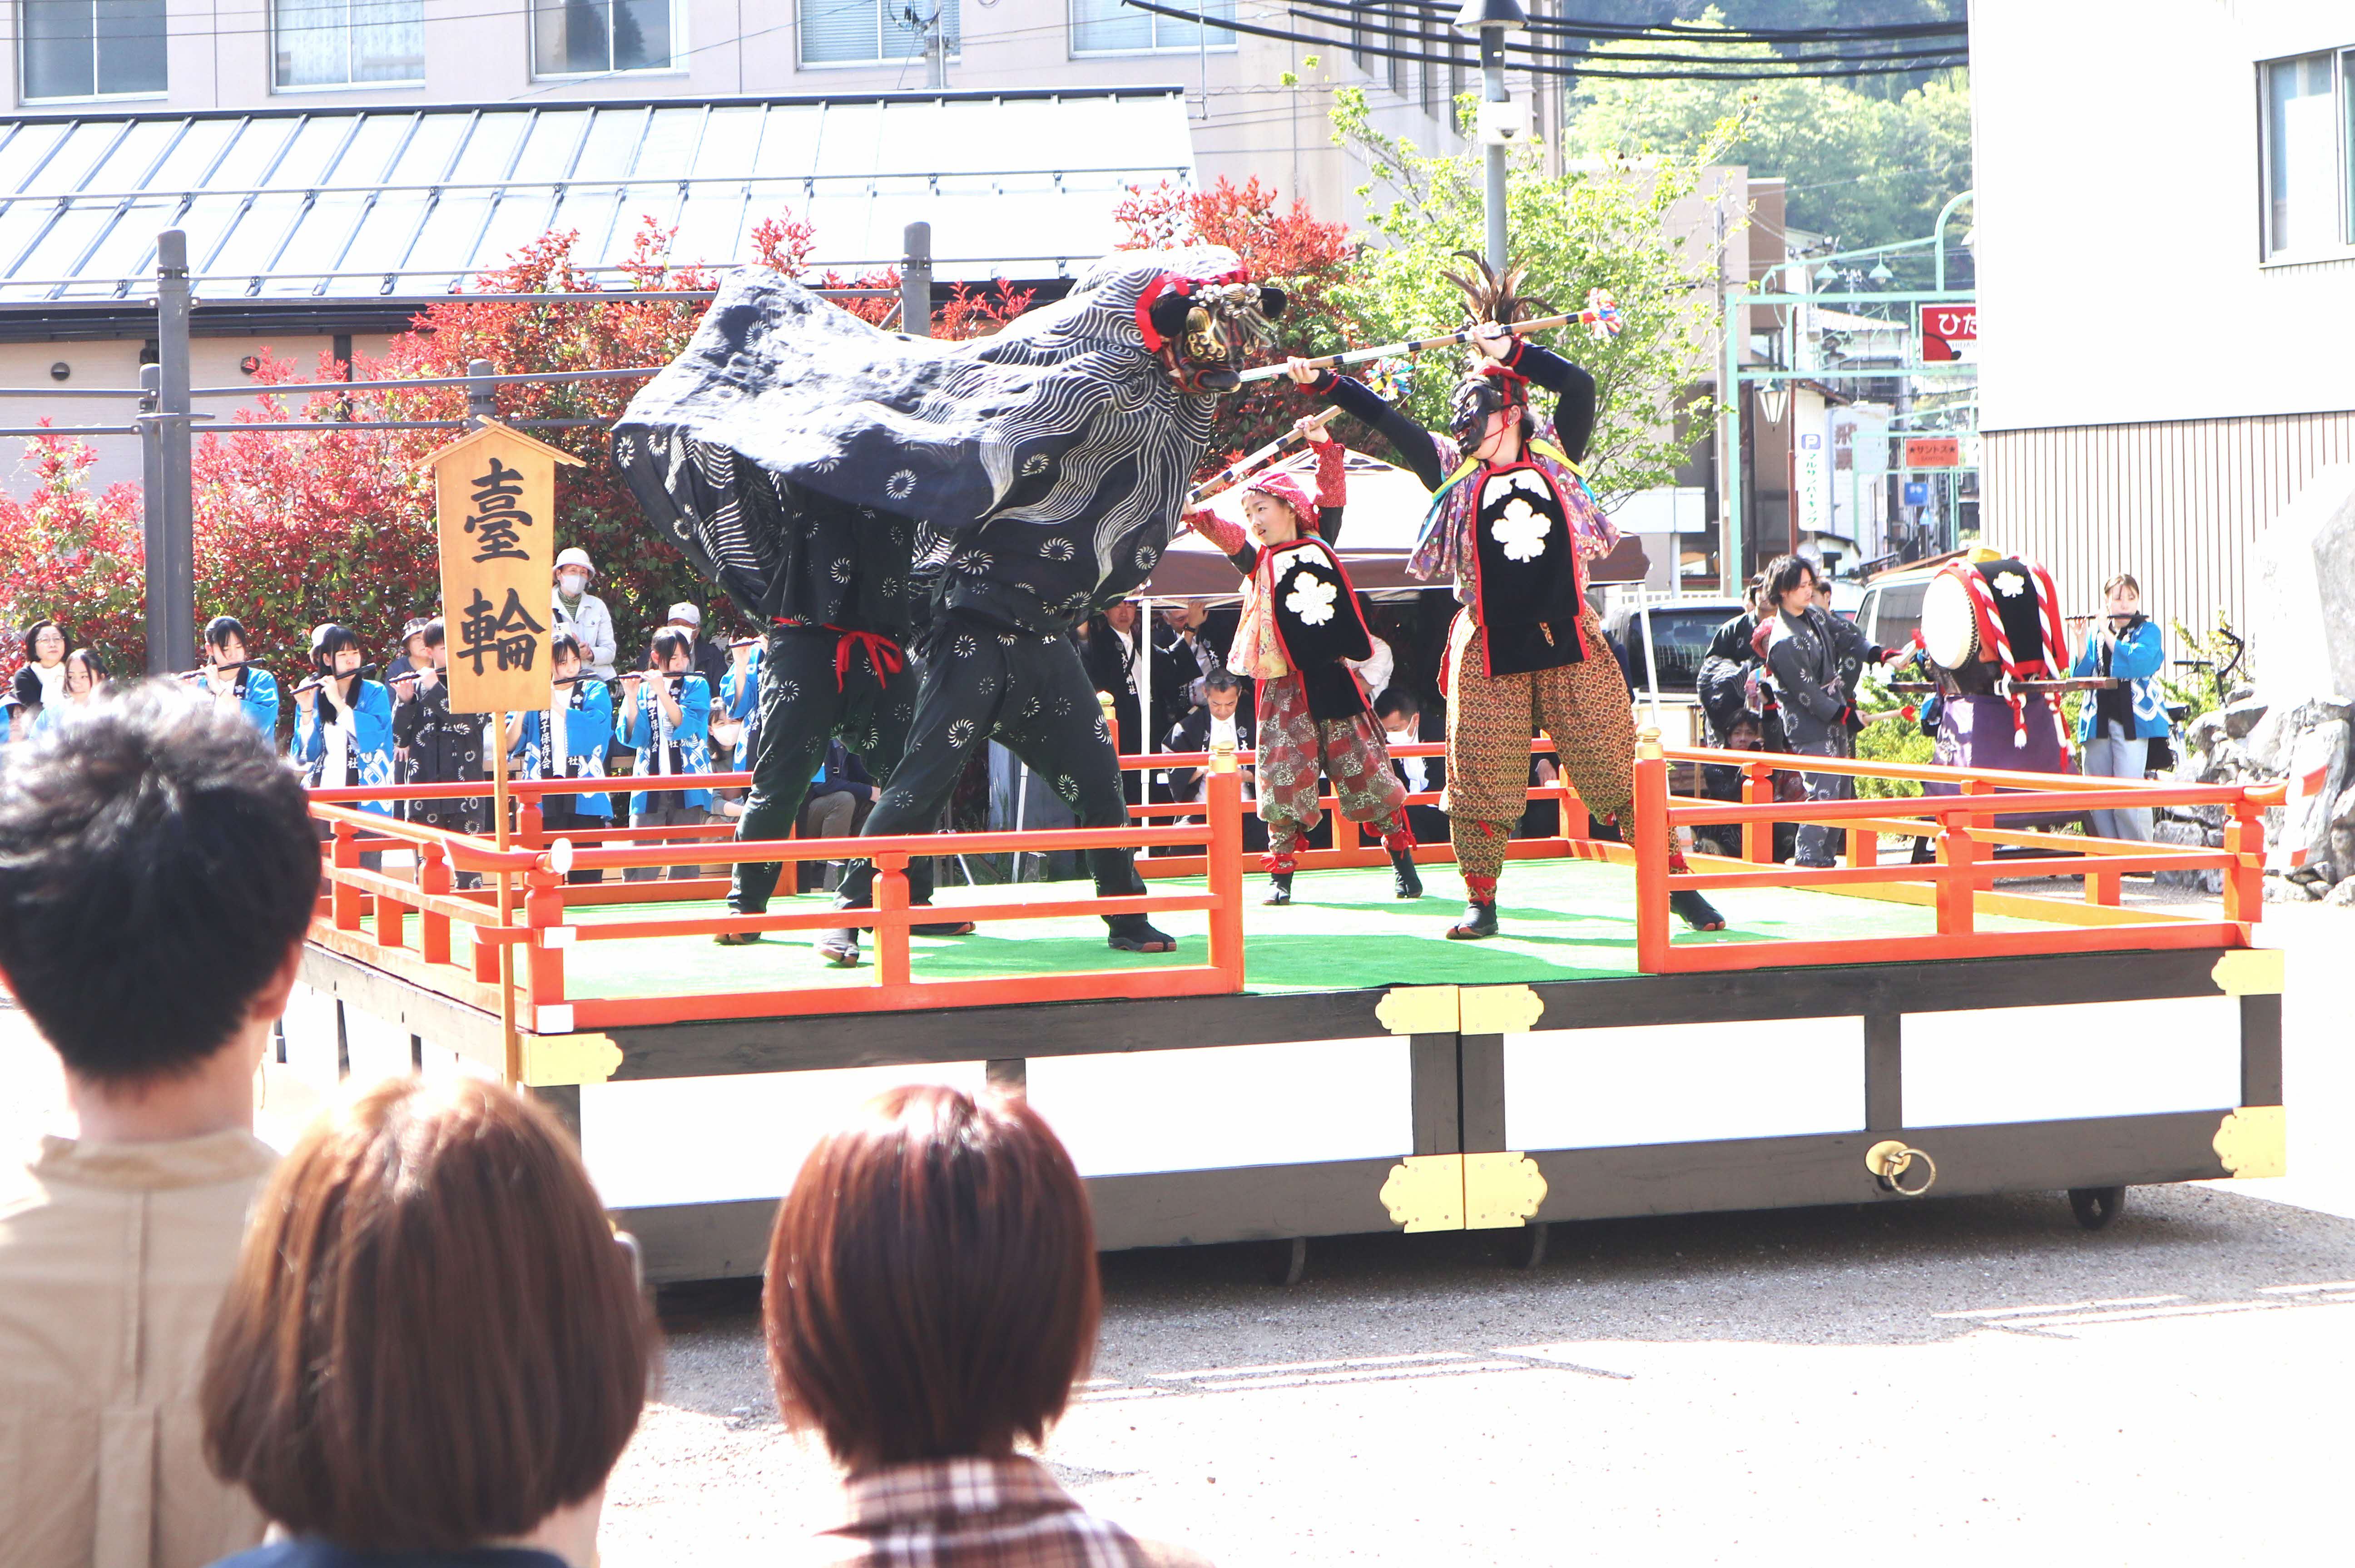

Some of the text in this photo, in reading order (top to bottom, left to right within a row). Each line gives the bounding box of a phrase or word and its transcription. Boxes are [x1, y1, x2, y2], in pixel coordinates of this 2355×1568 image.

[456, 458, 546, 676] 臺輪
[539, 710, 551, 769] 獅子保存会
